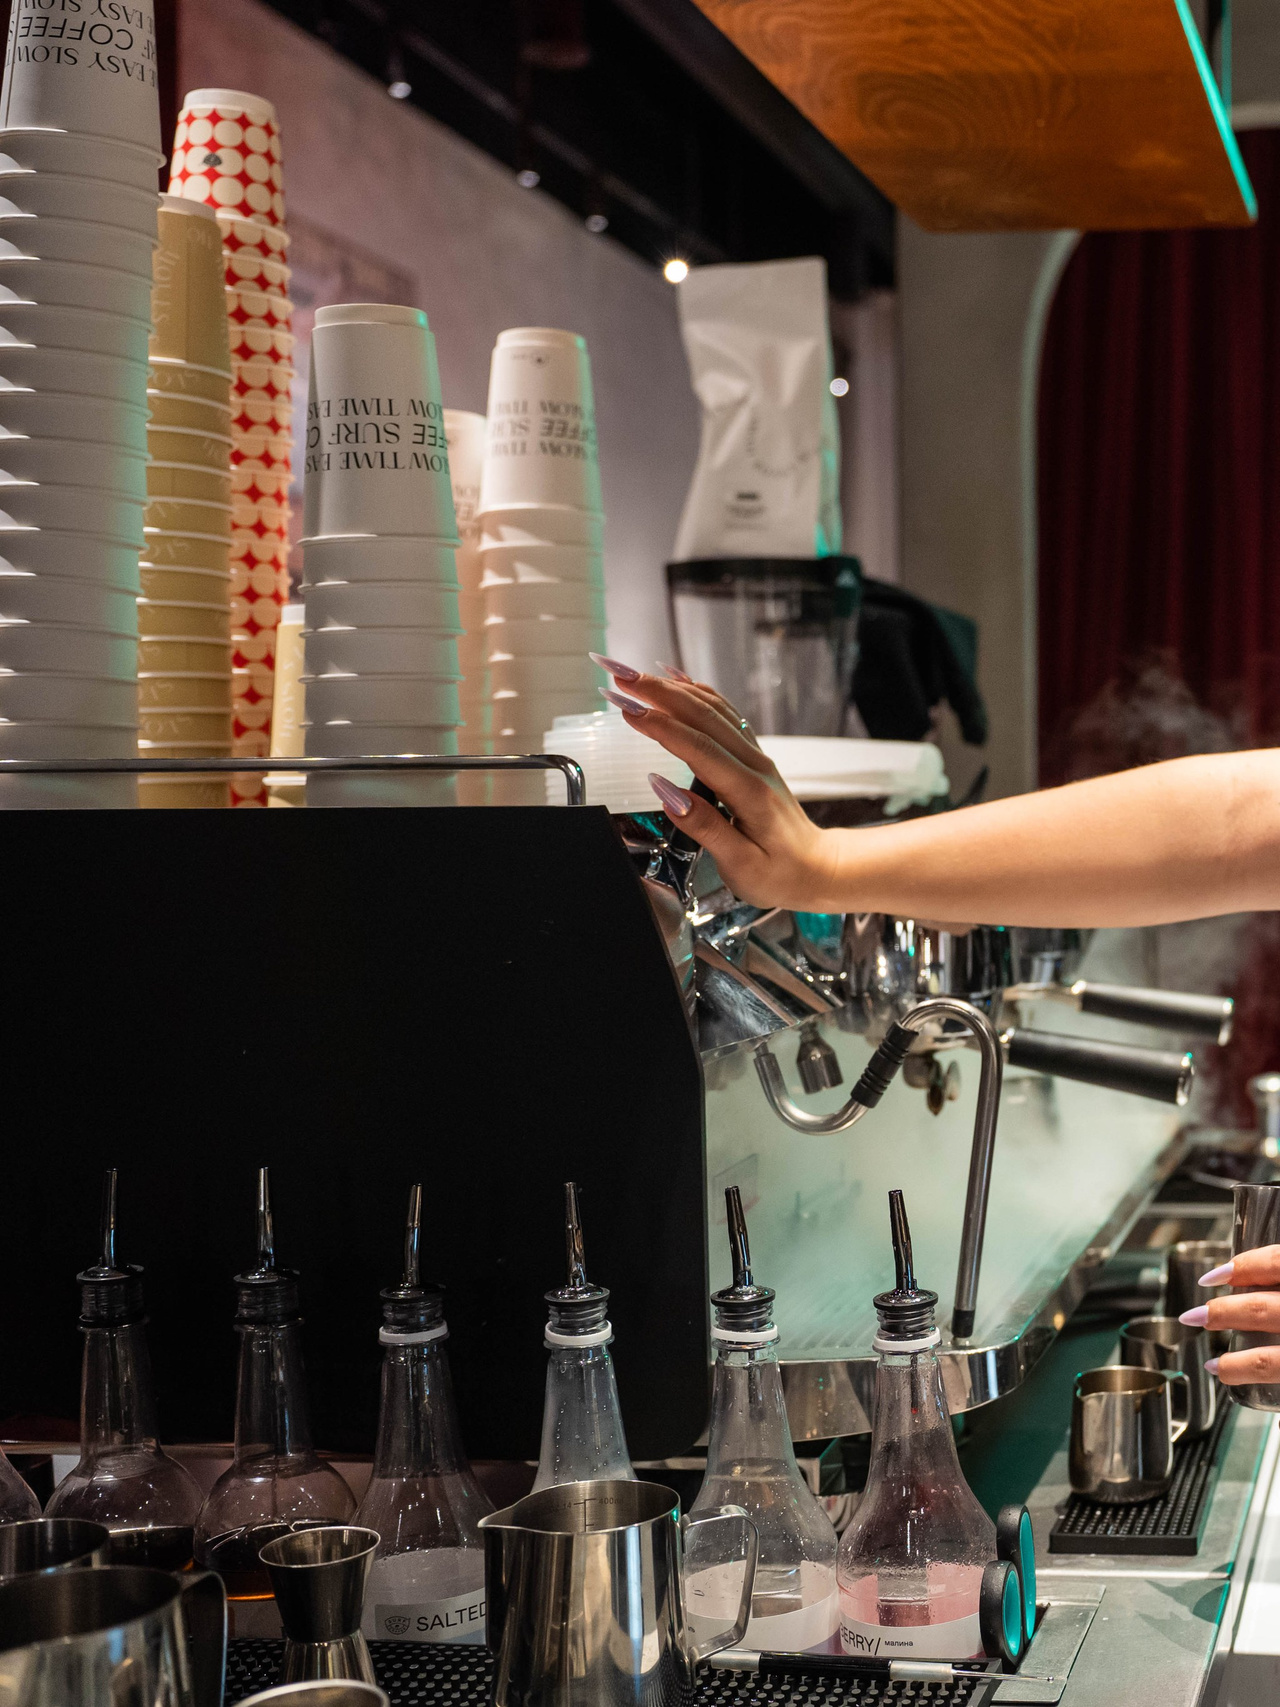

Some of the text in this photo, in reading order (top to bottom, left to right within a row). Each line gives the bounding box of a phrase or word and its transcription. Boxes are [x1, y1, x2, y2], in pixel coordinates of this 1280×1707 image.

[90, 0, 143, 29] EASY
[19, 16, 134, 50] COFFEE
[13, 45, 80, 66] SLOW
[88, 52, 145, 82] EASY
[339, 398, 400, 416] TIME
[328, 422, 400, 446] SURF
[339, 452, 405, 471] TIME
